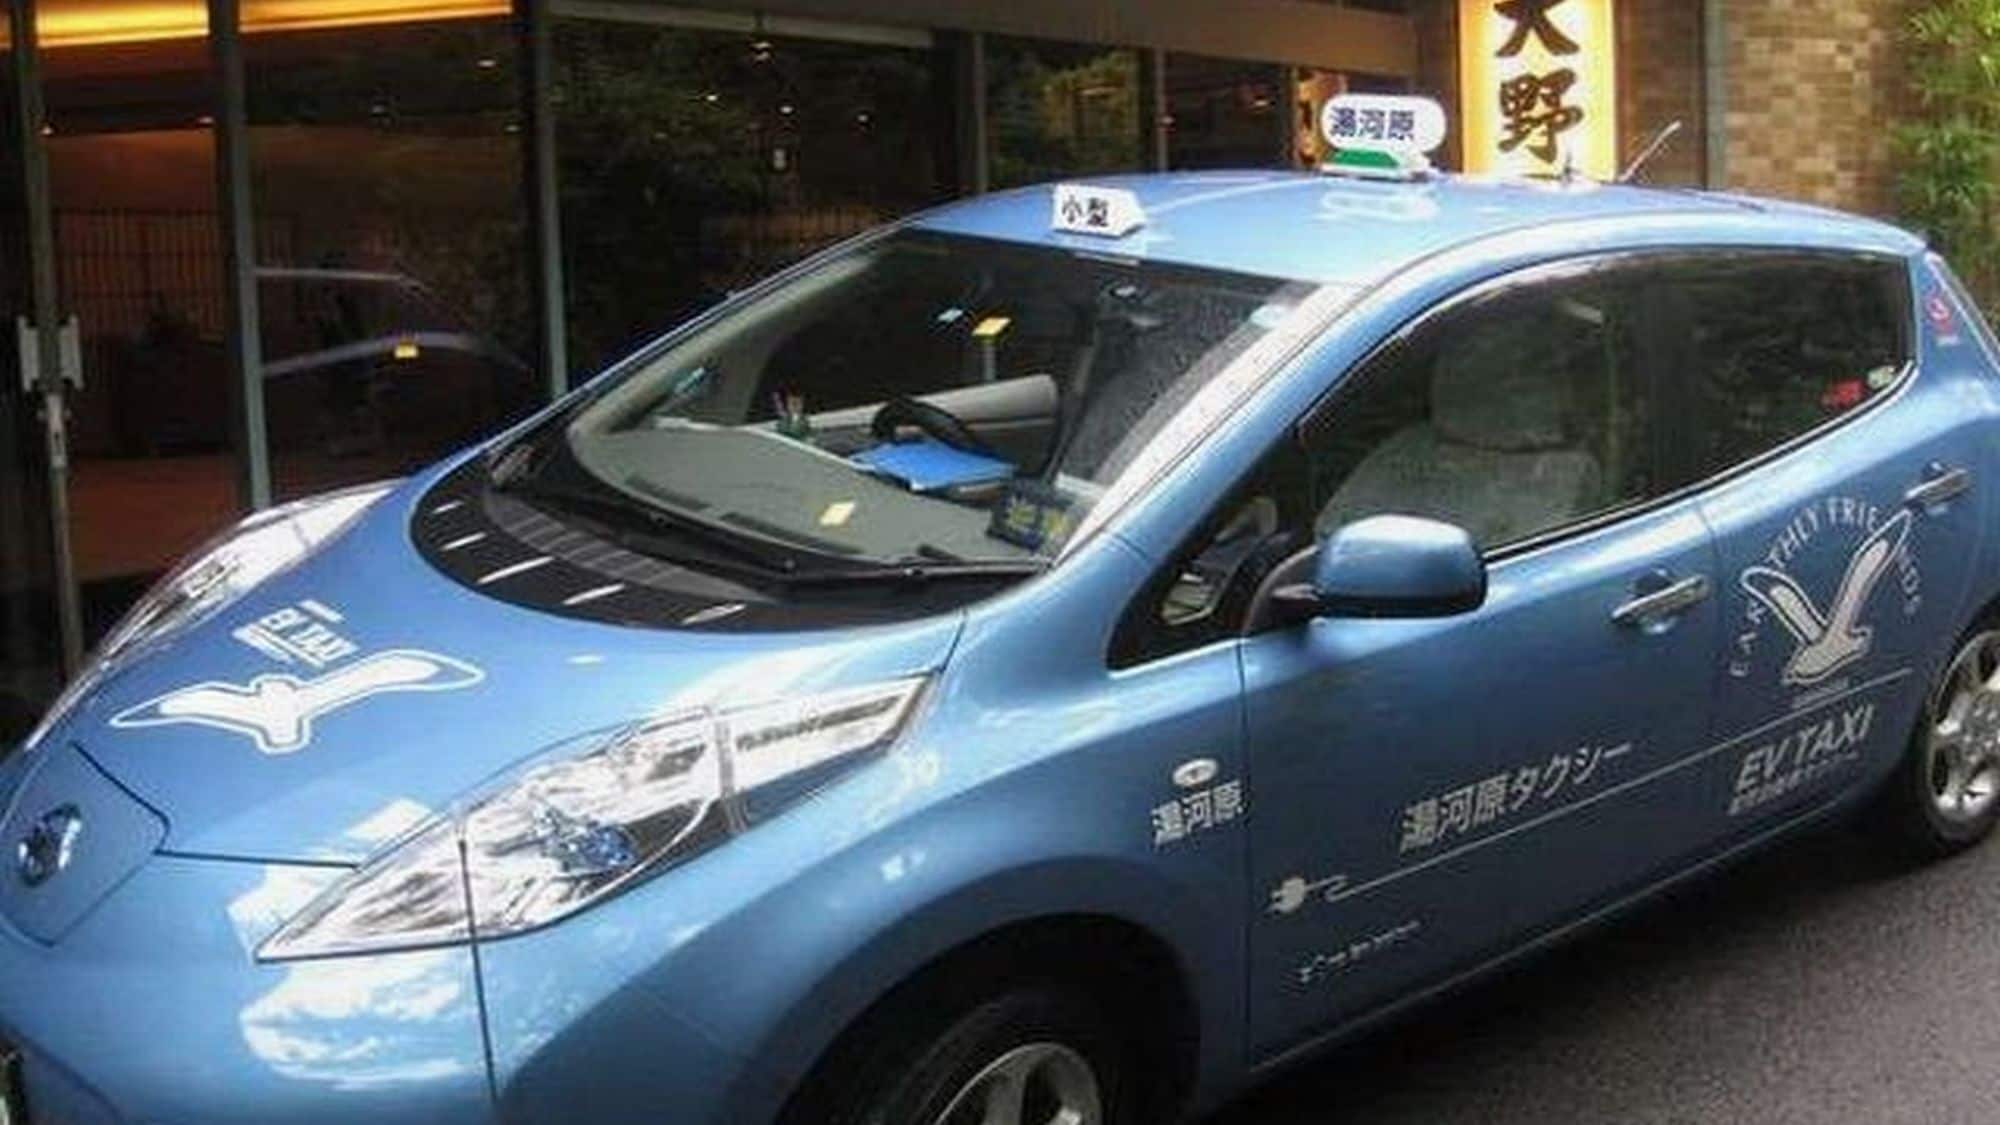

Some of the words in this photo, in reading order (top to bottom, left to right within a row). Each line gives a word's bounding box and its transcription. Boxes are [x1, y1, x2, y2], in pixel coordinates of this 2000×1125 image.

[1494, 0, 1584, 164] 大野
[1329, 104, 1415, 140] 湯河原
[1062, 194, 1109, 228] 小型
[1735, 737, 1791, 792] EV
[1794, 703, 1875, 767] TAXI
[1151, 780, 1247, 844] 湯河原
[1400, 743, 1632, 853] 湯河原タクシー
